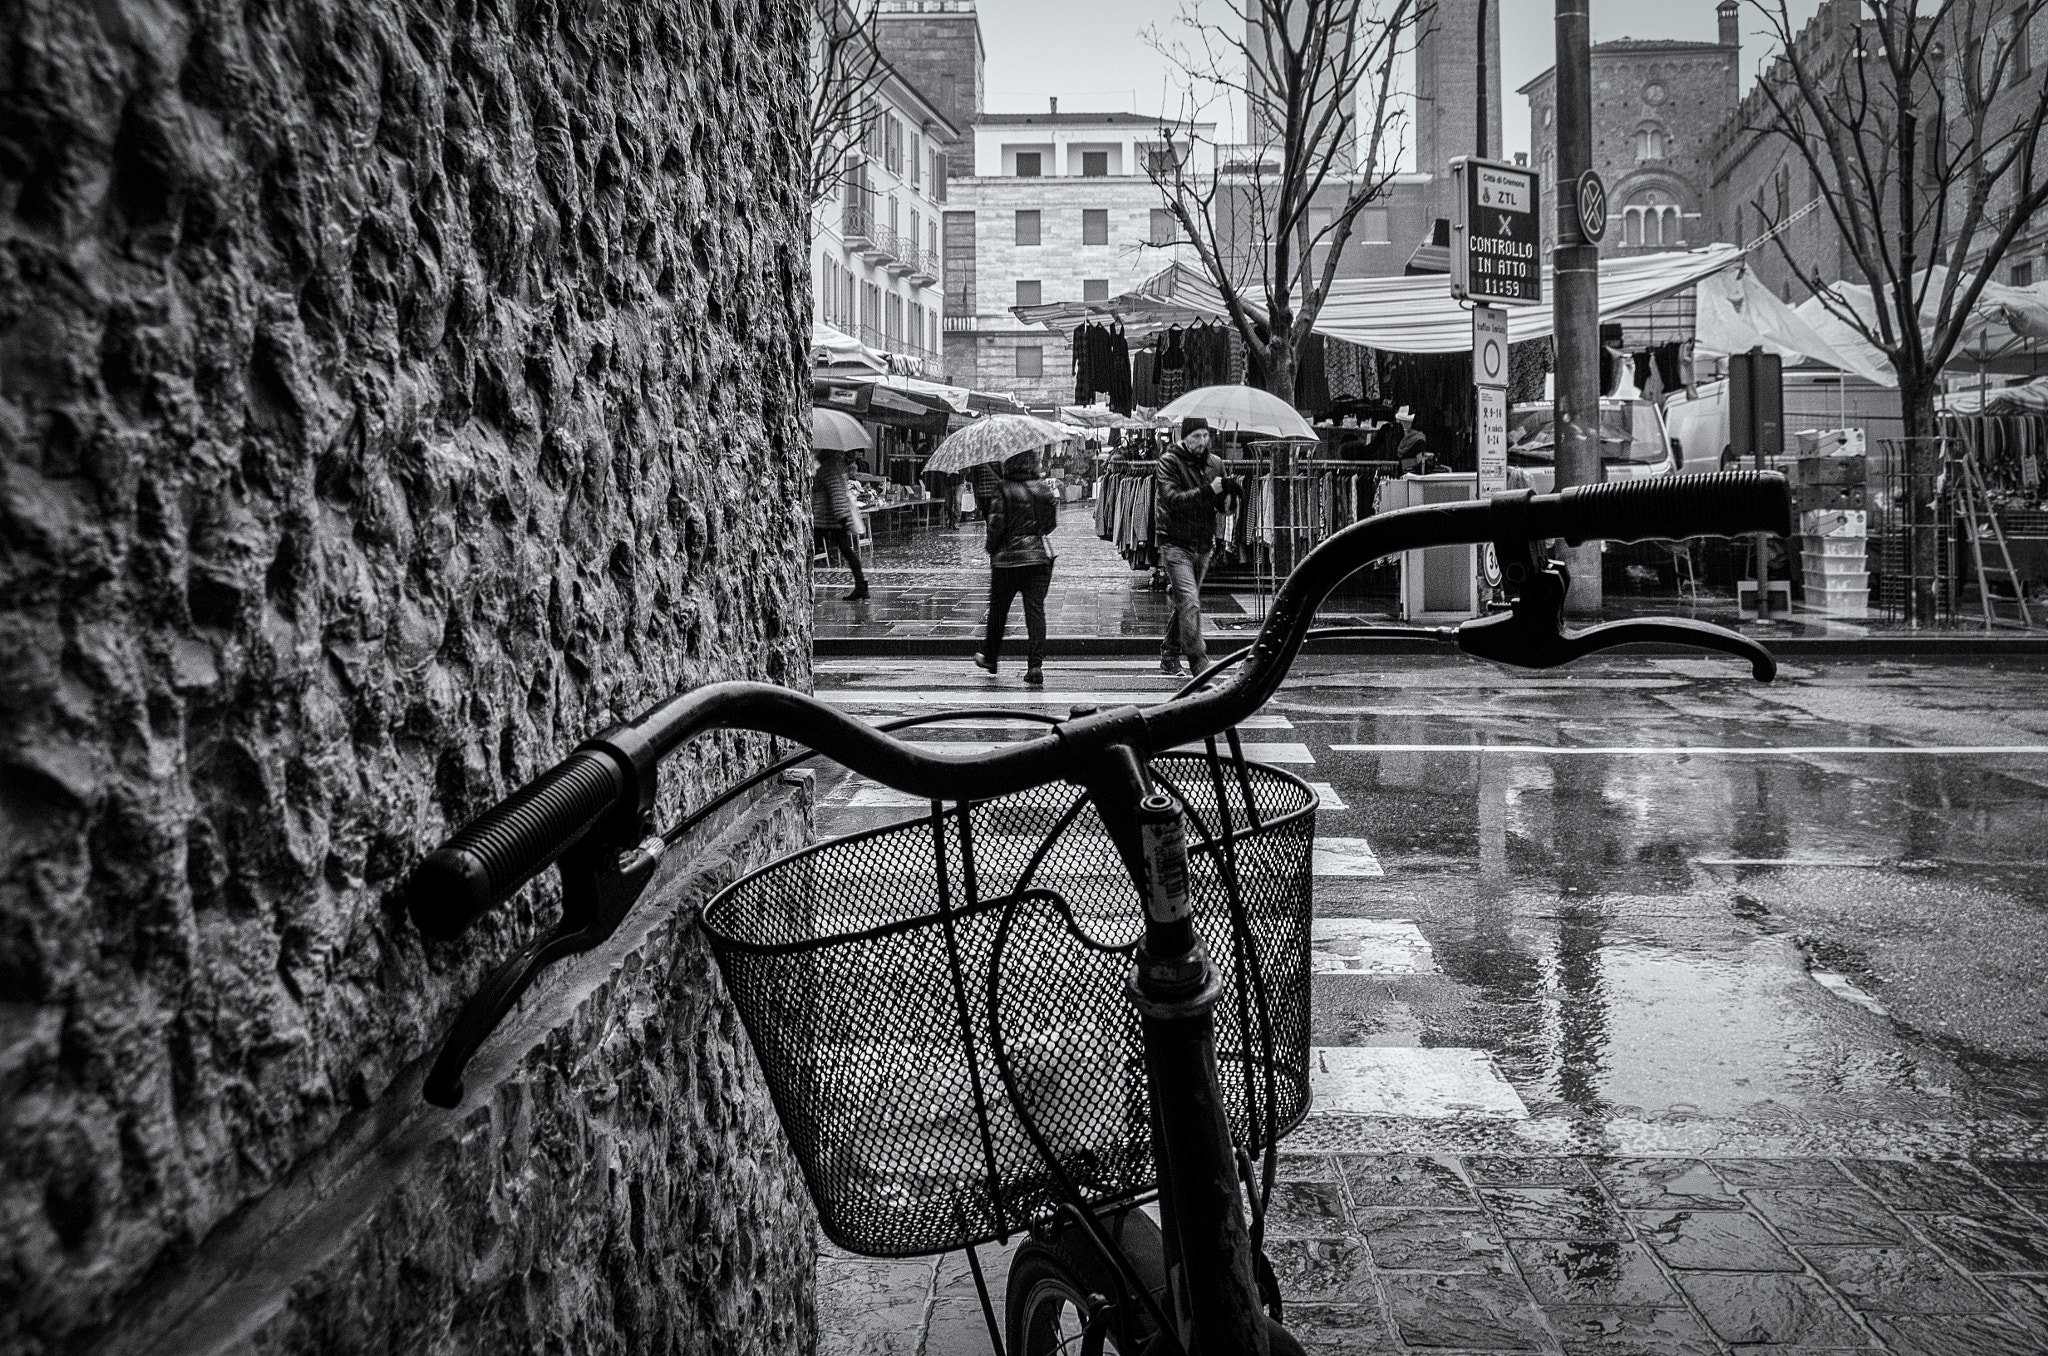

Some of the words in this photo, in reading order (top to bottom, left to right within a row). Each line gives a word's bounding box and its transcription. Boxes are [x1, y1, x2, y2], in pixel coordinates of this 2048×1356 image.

[1498, 191, 1517, 205] ZTL
[1470, 235, 1533, 258] CONTROLLO
[1478, 256, 1491, 273] IN
[1498, 260, 1526, 278] ATTO
[1485, 278, 1519, 296] 11:59
